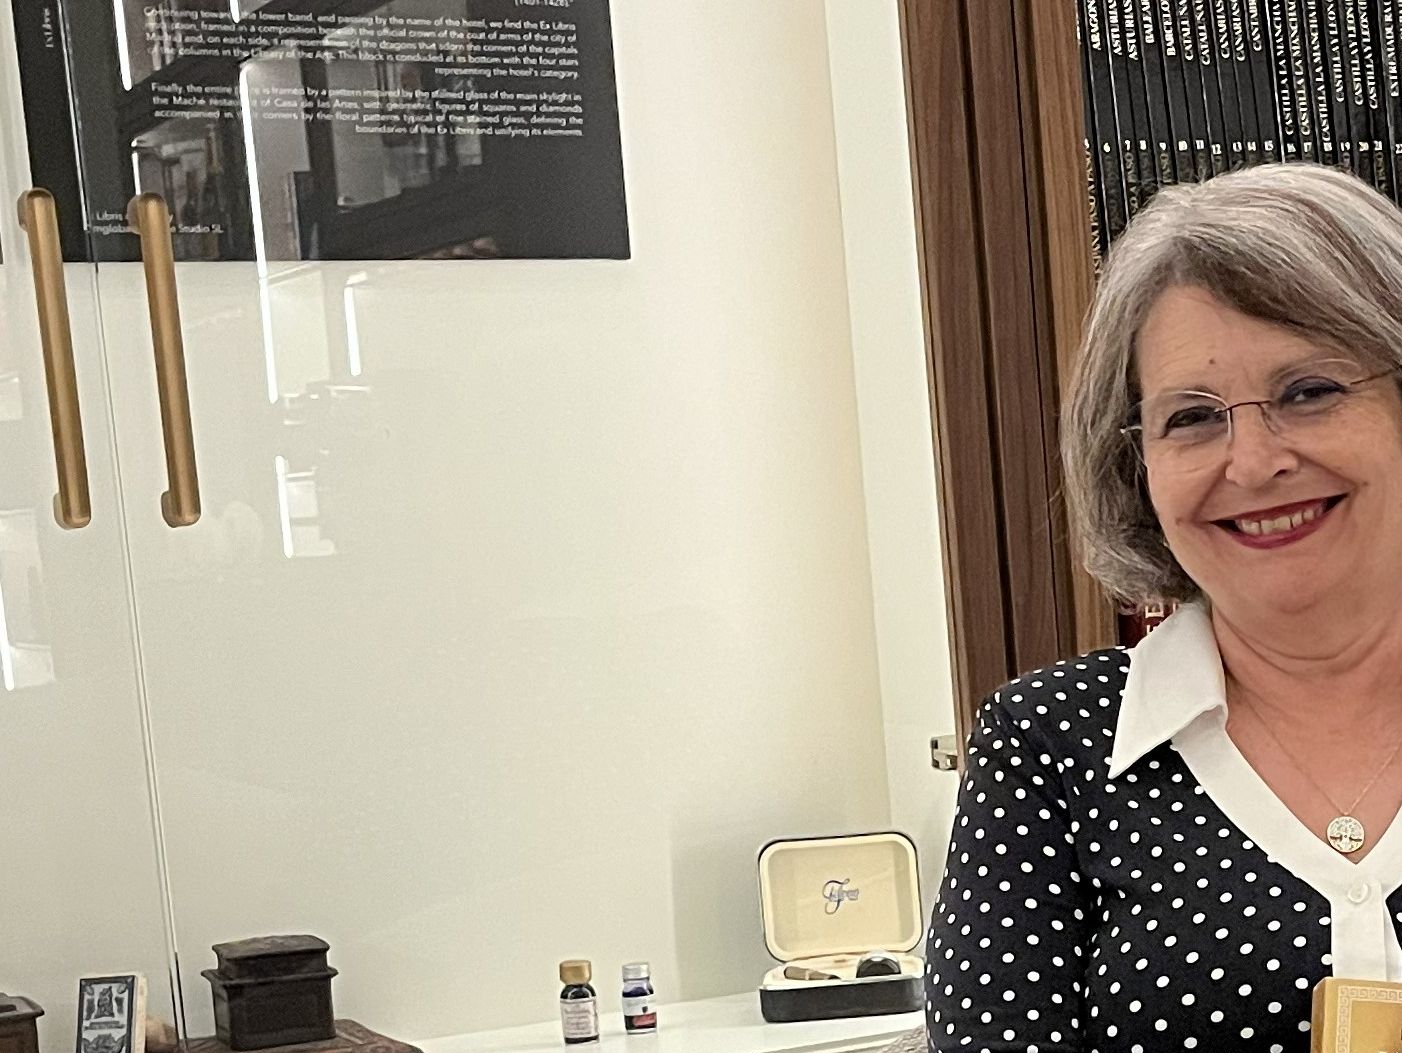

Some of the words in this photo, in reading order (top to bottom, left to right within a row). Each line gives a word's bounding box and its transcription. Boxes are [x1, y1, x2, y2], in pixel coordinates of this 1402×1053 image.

[1278, 59, 1288, 75] LA
[1294, 60, 1304, 76] LA
[1315, 66, 1325, 82] LA
[1331, 45, 1345, 102] CASTILLA
[1350, 49, 1364, 105] CASTILLA
[1383, 6, 1399, 97] EXTREMADURA
[1281, 78, 1295, 136] CASTILLA
[1297, 78, 1311, 136] CASTILLA
[1364, 53, 1378, 109] CASTILLA
[1317, 84, 1331, 141] CASTILLA
